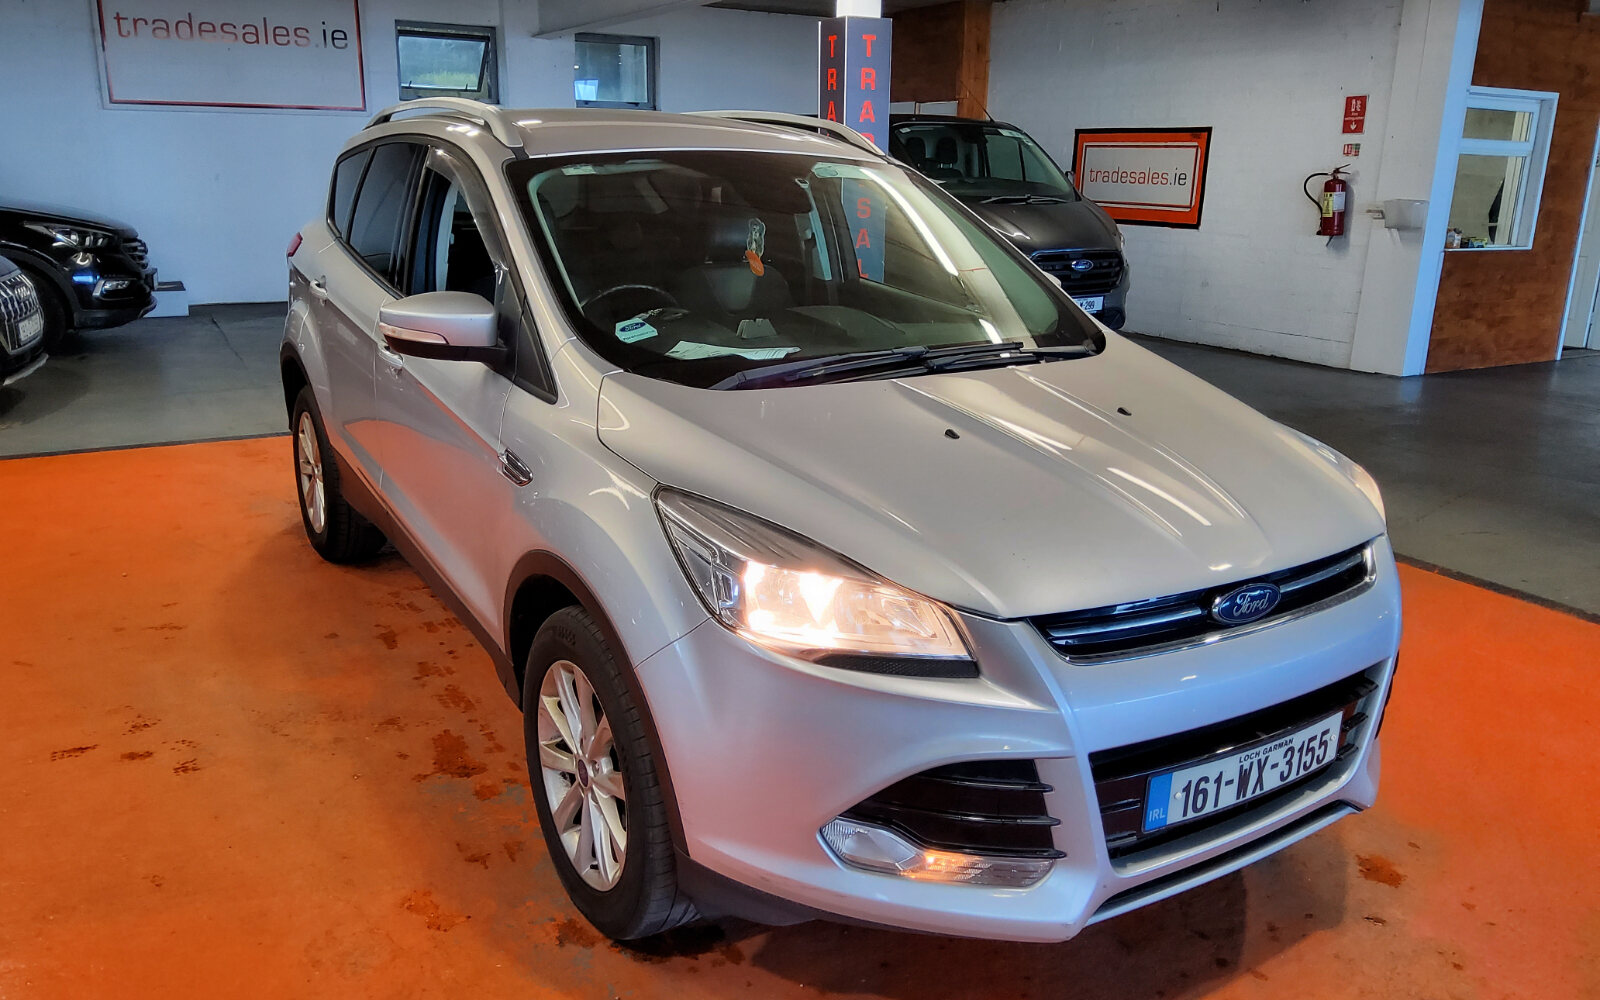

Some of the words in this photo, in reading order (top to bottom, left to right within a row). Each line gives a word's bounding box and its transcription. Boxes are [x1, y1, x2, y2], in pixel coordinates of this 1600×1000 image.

[113, 12, 349, 50] tradesales.ie
[827, 34, 837, 137] TRA
[1089, 165, 1187, 186] tradesales.ie
[1233, 589, 1272, 616] Ford
[1239, 750, 1261, 763] LOCH
[1181, 728, 1331, 818] 161-WX-3155
[1149, 809, 1166, 822] IRL
